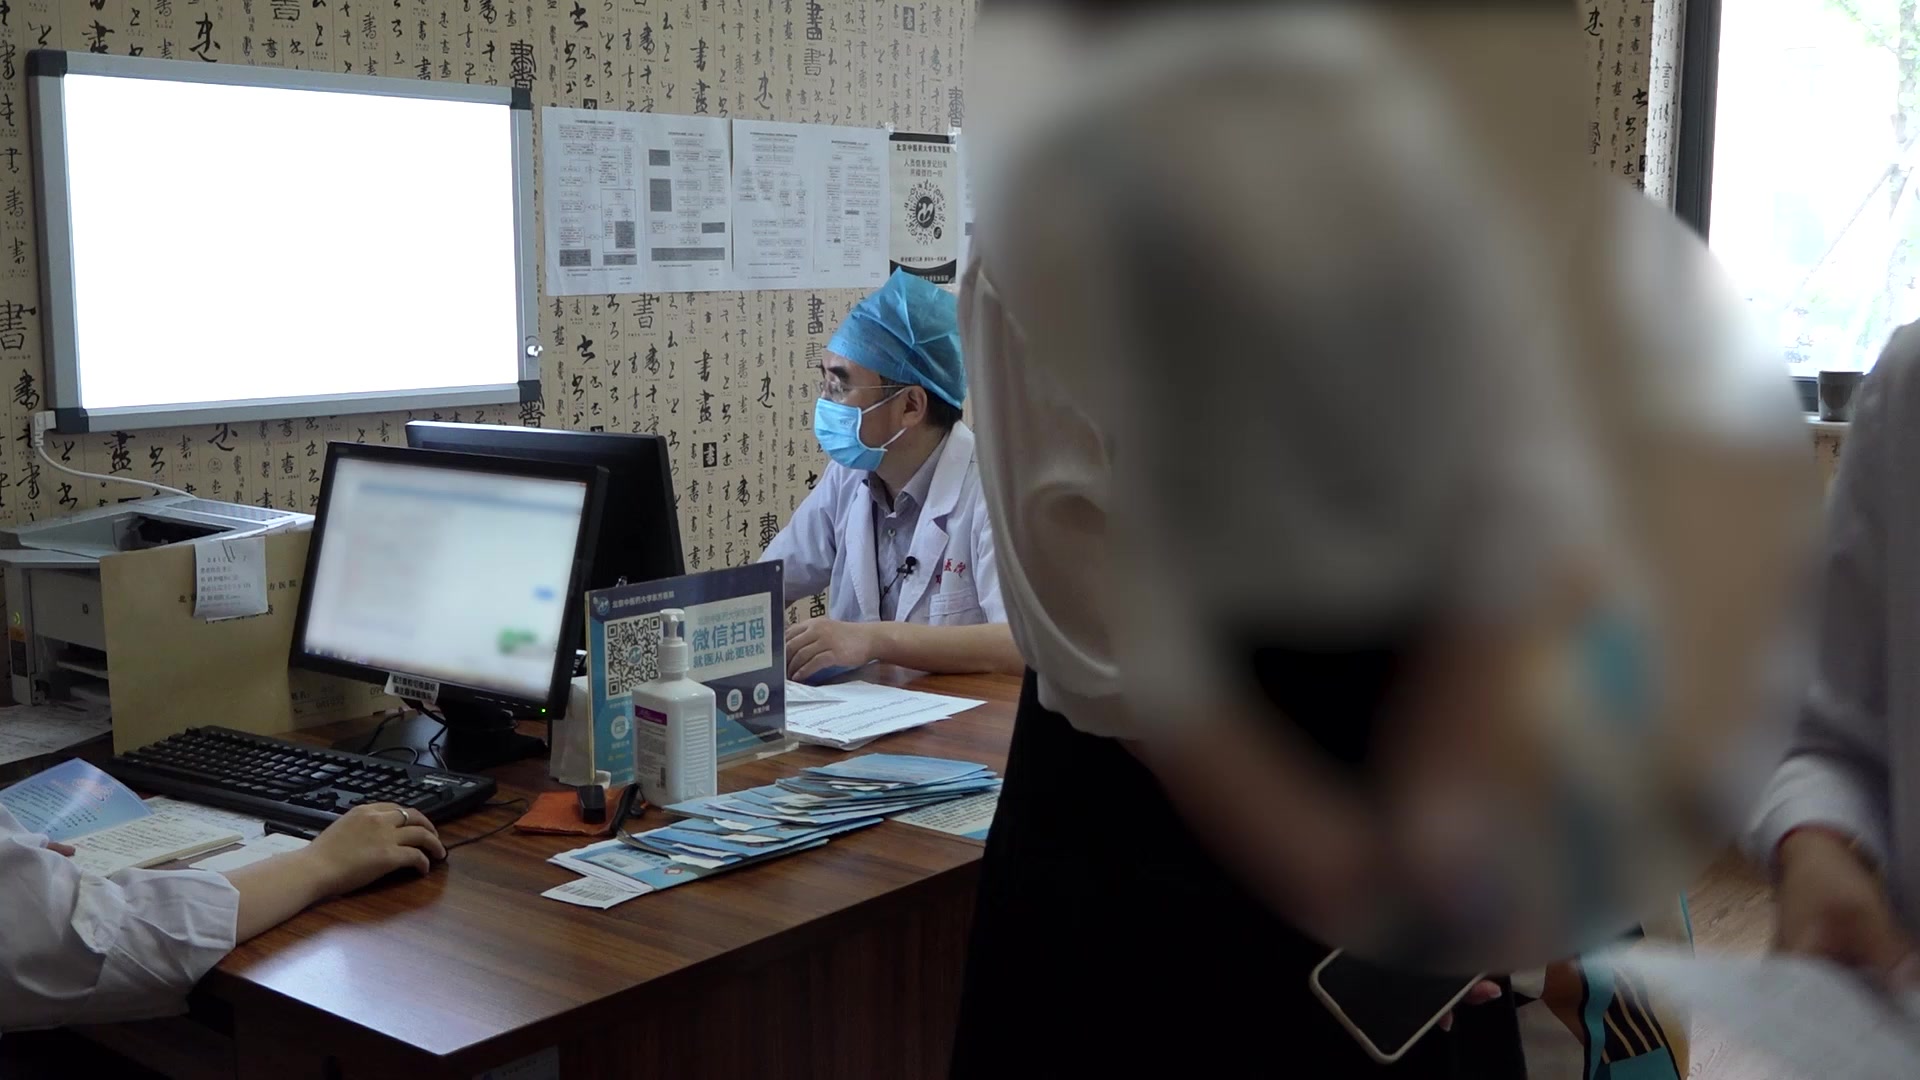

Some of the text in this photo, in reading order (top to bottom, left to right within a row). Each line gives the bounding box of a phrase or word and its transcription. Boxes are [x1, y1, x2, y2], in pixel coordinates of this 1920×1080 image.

[692, 617, 766, 652] 微信扫码
[693, 642, 765, 669] 就医从此更轻松
